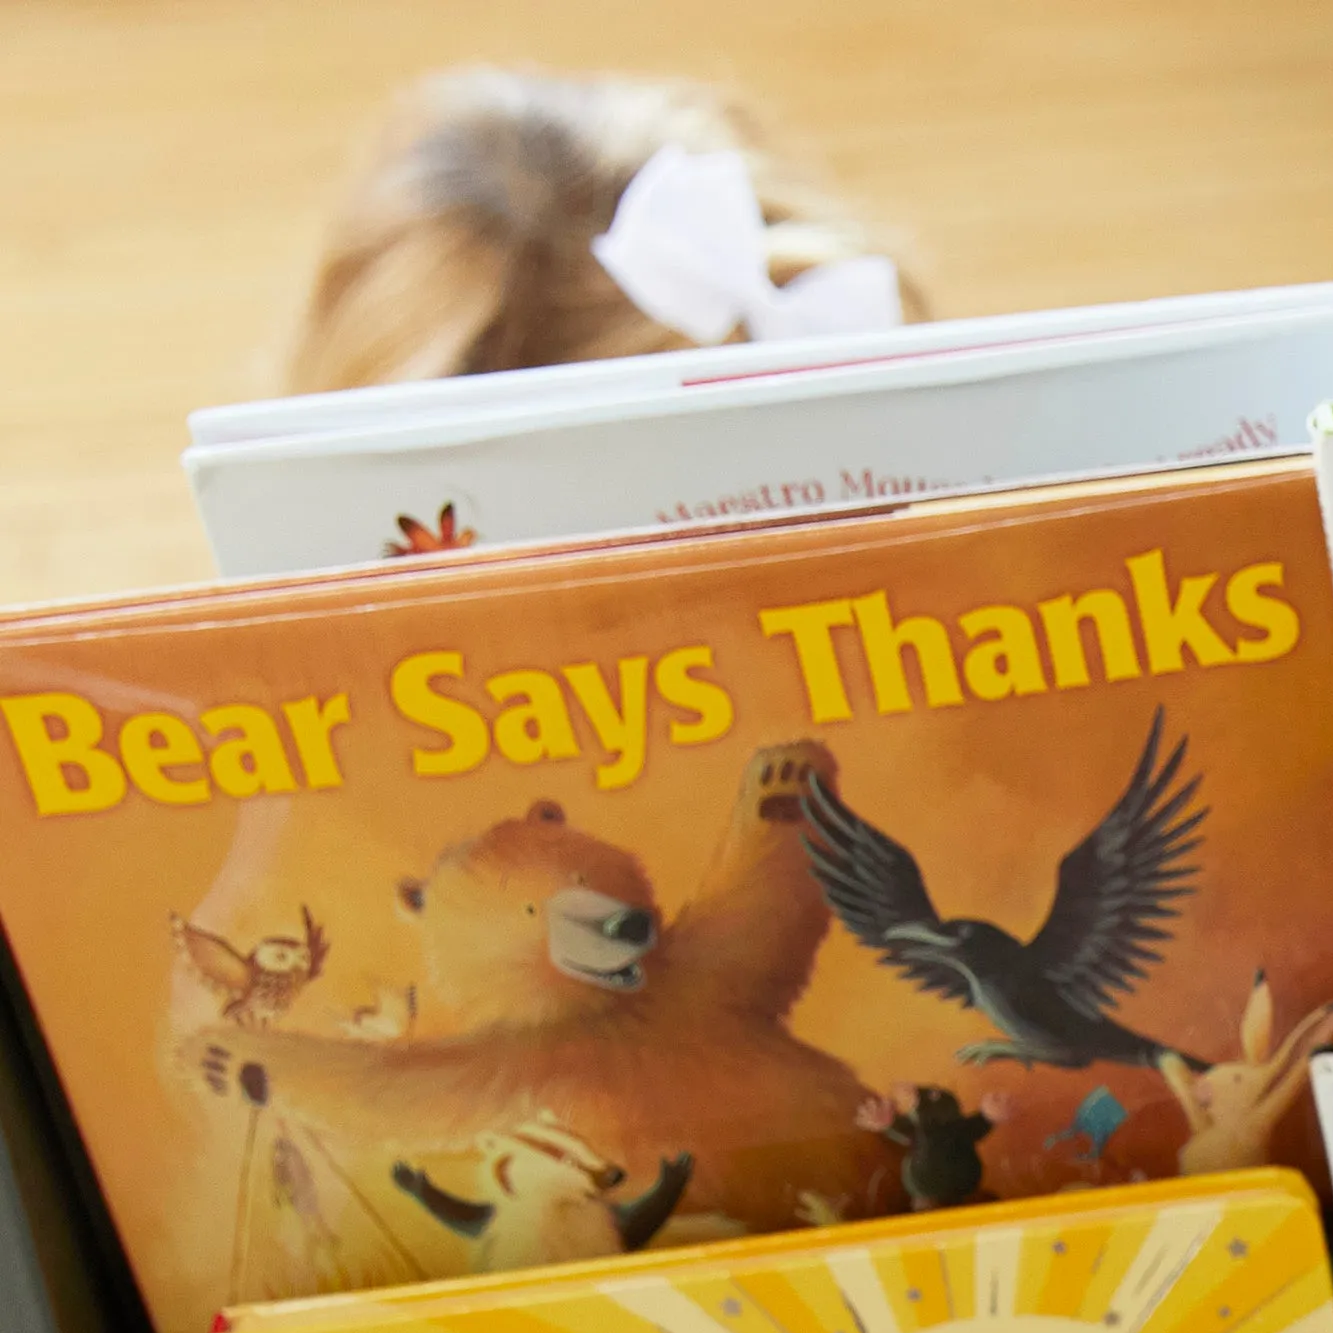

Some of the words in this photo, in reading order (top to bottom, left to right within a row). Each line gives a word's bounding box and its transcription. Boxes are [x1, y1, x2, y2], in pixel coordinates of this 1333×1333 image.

[2, 689, 352, 818] Bear
[389, 643, 736, 791] Says
[759, 547, 1303, 726] Thanks
